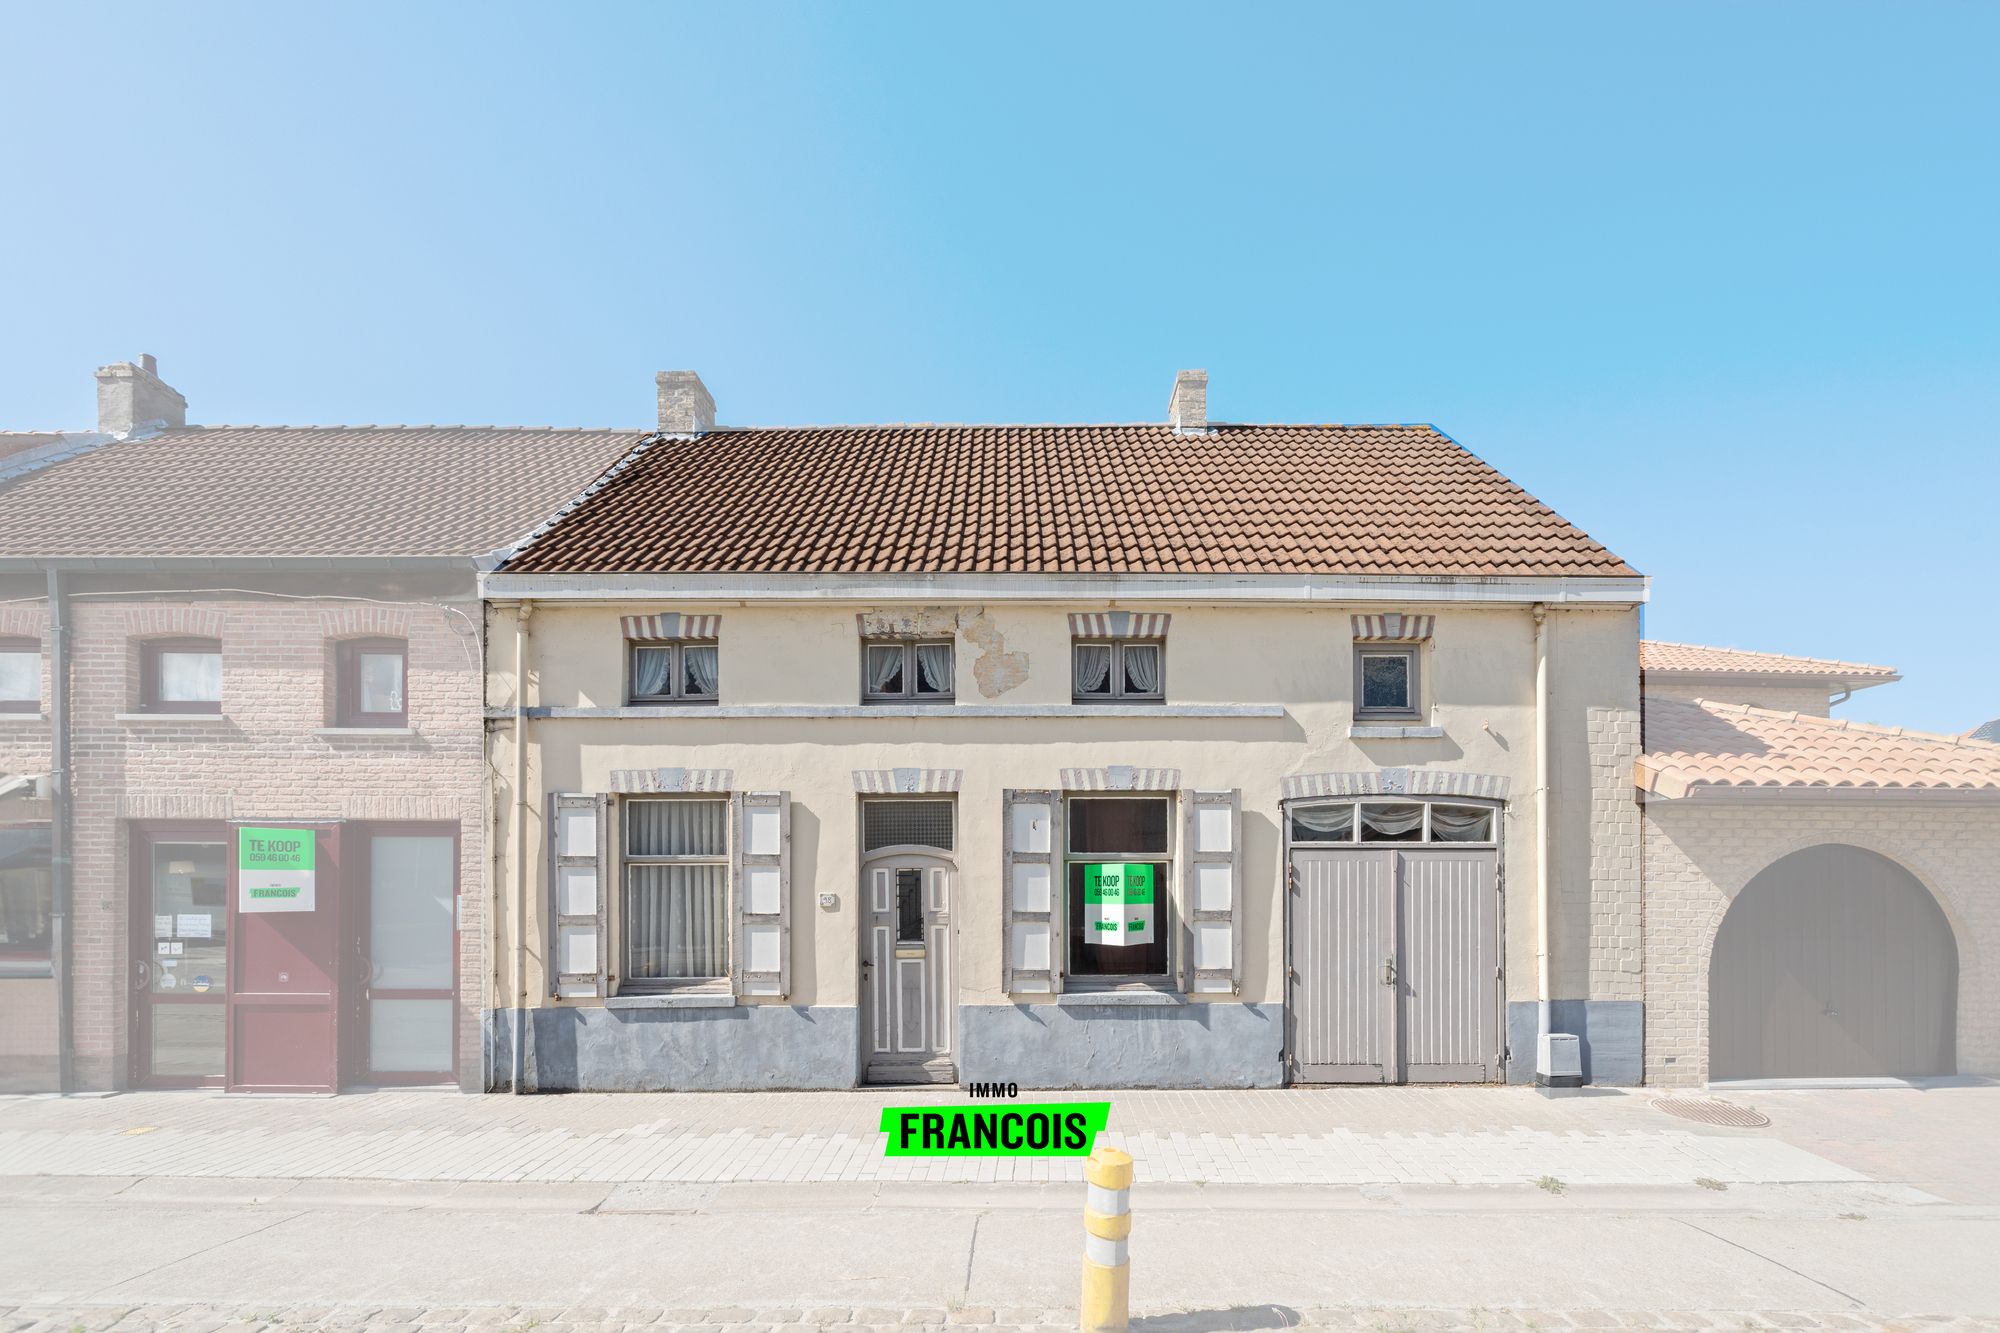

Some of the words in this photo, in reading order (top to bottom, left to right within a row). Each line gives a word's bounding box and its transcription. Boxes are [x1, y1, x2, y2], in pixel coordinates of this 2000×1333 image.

[249, 839, 265, 851] TE
[268, 840, 301, 852] KOOP
[267, 853, 278, 862] 46
[291, 854, 301, 863] 46
[1094, 875, 1102, 887] TE
[1102, 875, 1119, 887] KOOP
[1133, 875, 1146, 887] KOOP
[253, 889, 296, 898] FRANCOIS
[1096, 922, 1118, 931] FRANCOIS
